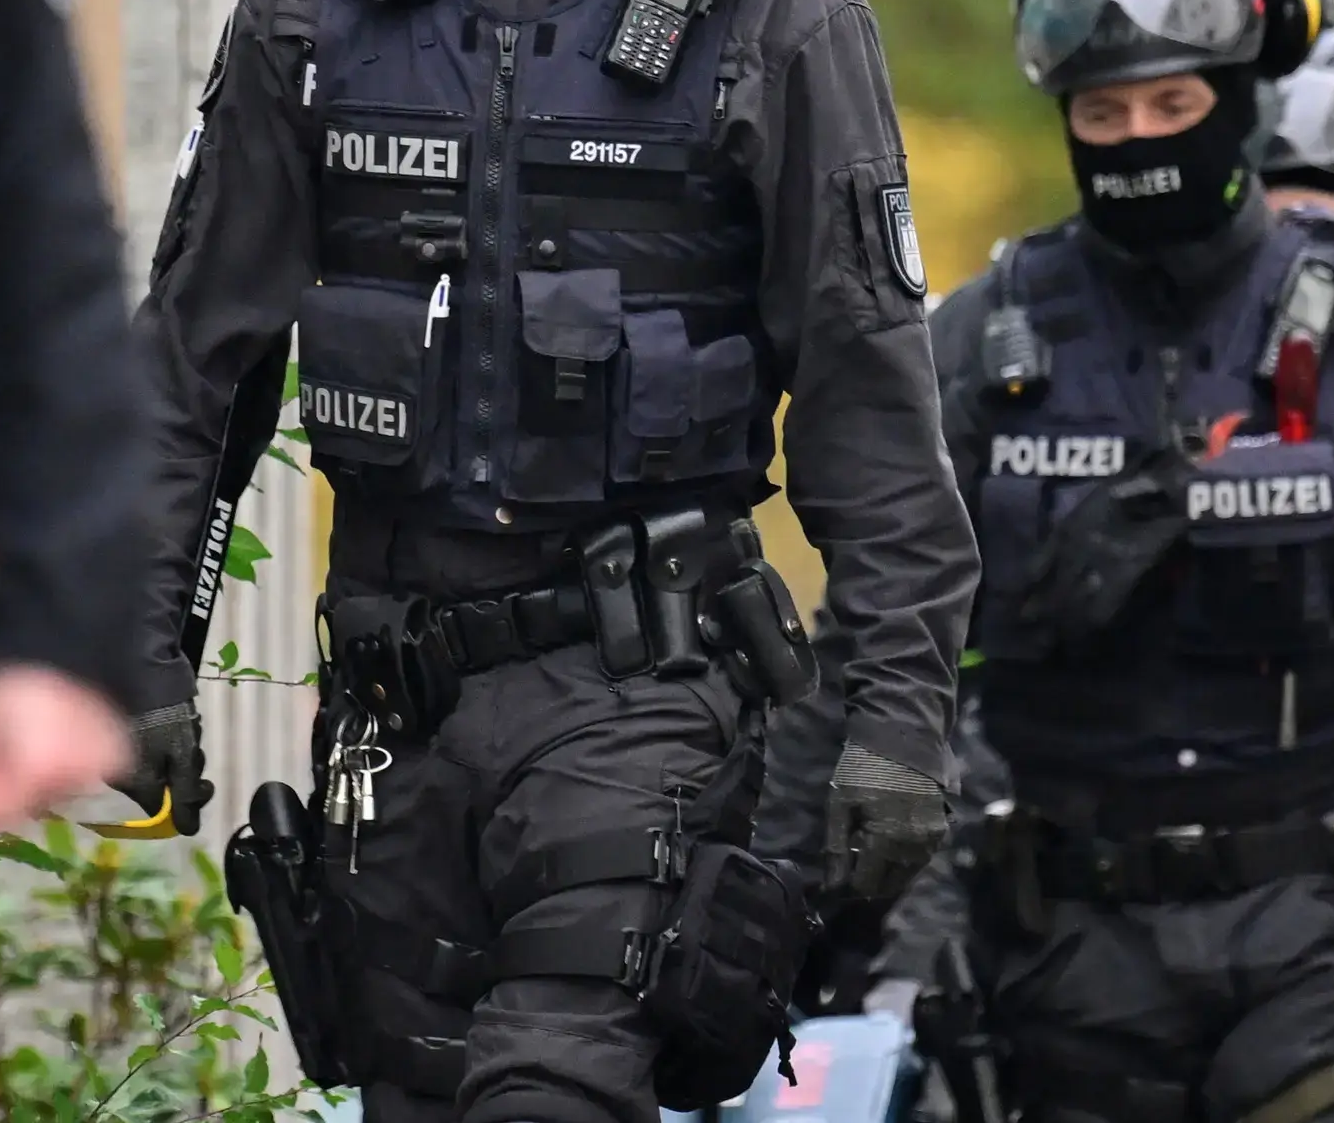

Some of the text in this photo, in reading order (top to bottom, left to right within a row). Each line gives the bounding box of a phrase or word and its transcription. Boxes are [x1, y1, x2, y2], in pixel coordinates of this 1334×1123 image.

[325, 129, 459, 179] POLIZEI
[569, 140, 642, 164] 291157
[300, 382, 407, 438] POLIZEI
[991, 435, 1124, 476] POLIZEI
[1188, 474, 1332, 520] POLIZEI
[191, 497, 232, 620] POLIZEI
